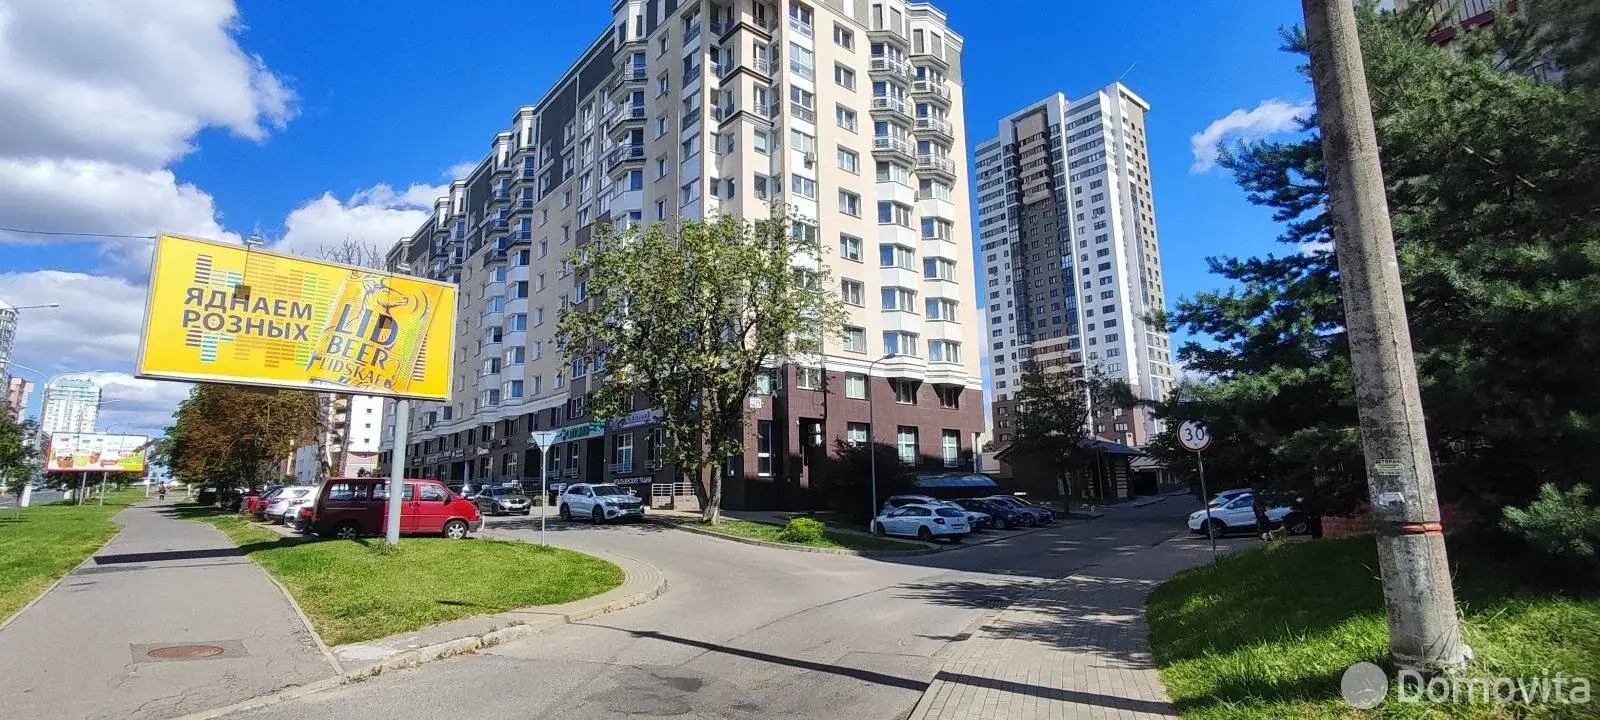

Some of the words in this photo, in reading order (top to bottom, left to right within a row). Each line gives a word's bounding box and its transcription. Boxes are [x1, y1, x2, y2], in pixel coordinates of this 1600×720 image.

[184, 287, 313, 320] ЯДНАЕМ
[182, 309, 310, 342] РОЗНЫХ
[335, 303, 399, 346] LID
[326, 335, 389, 370] BEER
[1184, 426, 1205, 441] 30
